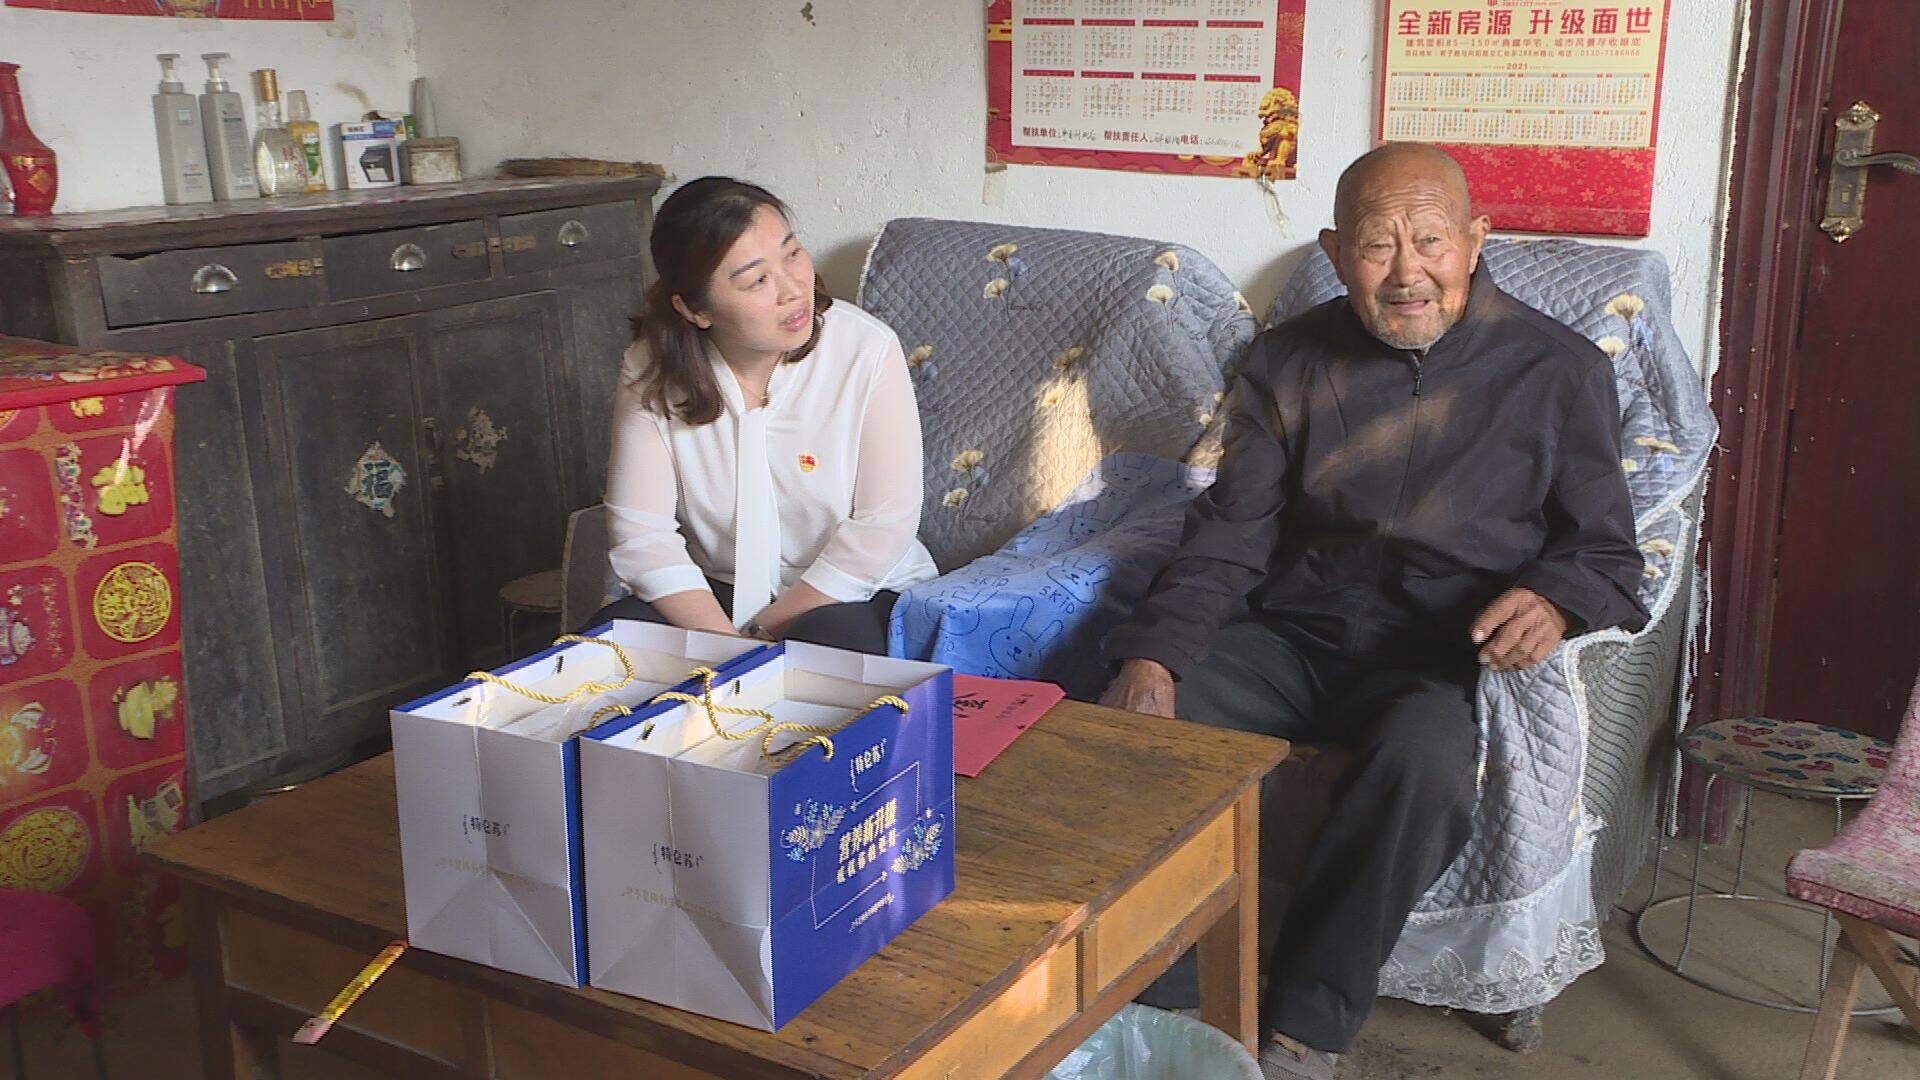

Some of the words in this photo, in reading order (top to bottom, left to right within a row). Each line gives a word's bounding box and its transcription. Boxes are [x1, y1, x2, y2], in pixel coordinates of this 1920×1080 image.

[1398, 9, 1513, 35] 全新房源
[1529, 7, 1653, 35] 升级面世
[1506, 62, 1528, 70] 2021
